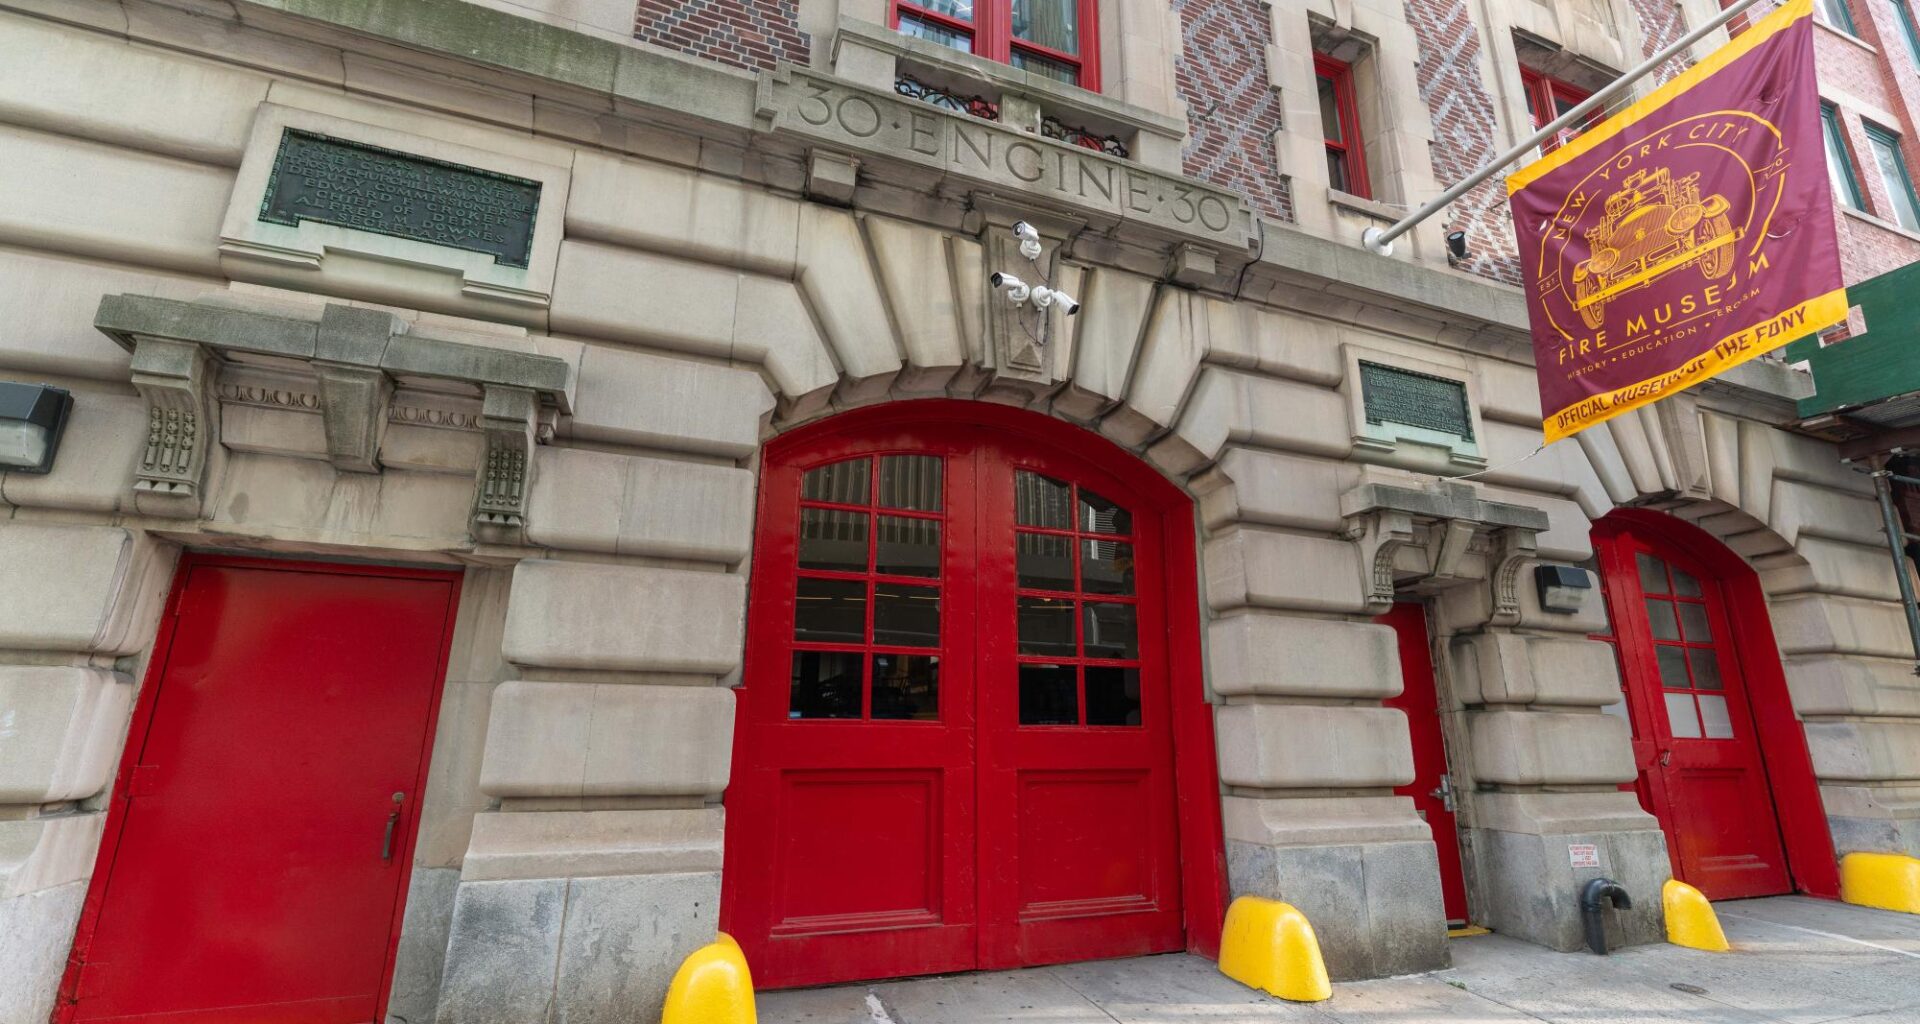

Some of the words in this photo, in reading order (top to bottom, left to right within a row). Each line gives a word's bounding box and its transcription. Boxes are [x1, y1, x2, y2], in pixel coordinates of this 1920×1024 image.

[298, 147, 346, 165] FIRE
[359, 160, 522, 202] COMMISSIONER
[312, 141, 415, 170] NICHOLAS
[449, 171, 514, 192] HAYES
[797, 86, 882, 138] 30
[909, 110, 1154, 214] ENGINE
[1170, 186, 1231, 232] 30
[1551, 191, 1586, 240] NEW
[1599, 133, 1672, 180] YORK
[1688, 122, 1750, 144] CITY
[288, 164, 366, 187] DEPUTY
[373, 182, 521, 219] COMMISSIONERS
[303, 177, 393, 202] EDWARD
[425, 201, 507, 226] CROKER
[314, 188, 377, 209] CHIEF
[391, 203, 415, 216] OF
[294, 194, 384, 219] ALFRED
[393, 213, 407, 224] M
[421, 219, 505, 243] DOWNES
[336, 211, 466, 244] SECRETARY
[1559, 329, 1607, 366] FIRE
[1567, 359, 1607, 381] HISTORY
[1621, 326, 1698, 360] EDUCATION
[1712, 288, 1761, 320] EROSM
[1557, 397, 1610, 429] OFFICIAL
[1712, 333, 1752, 361] THE
